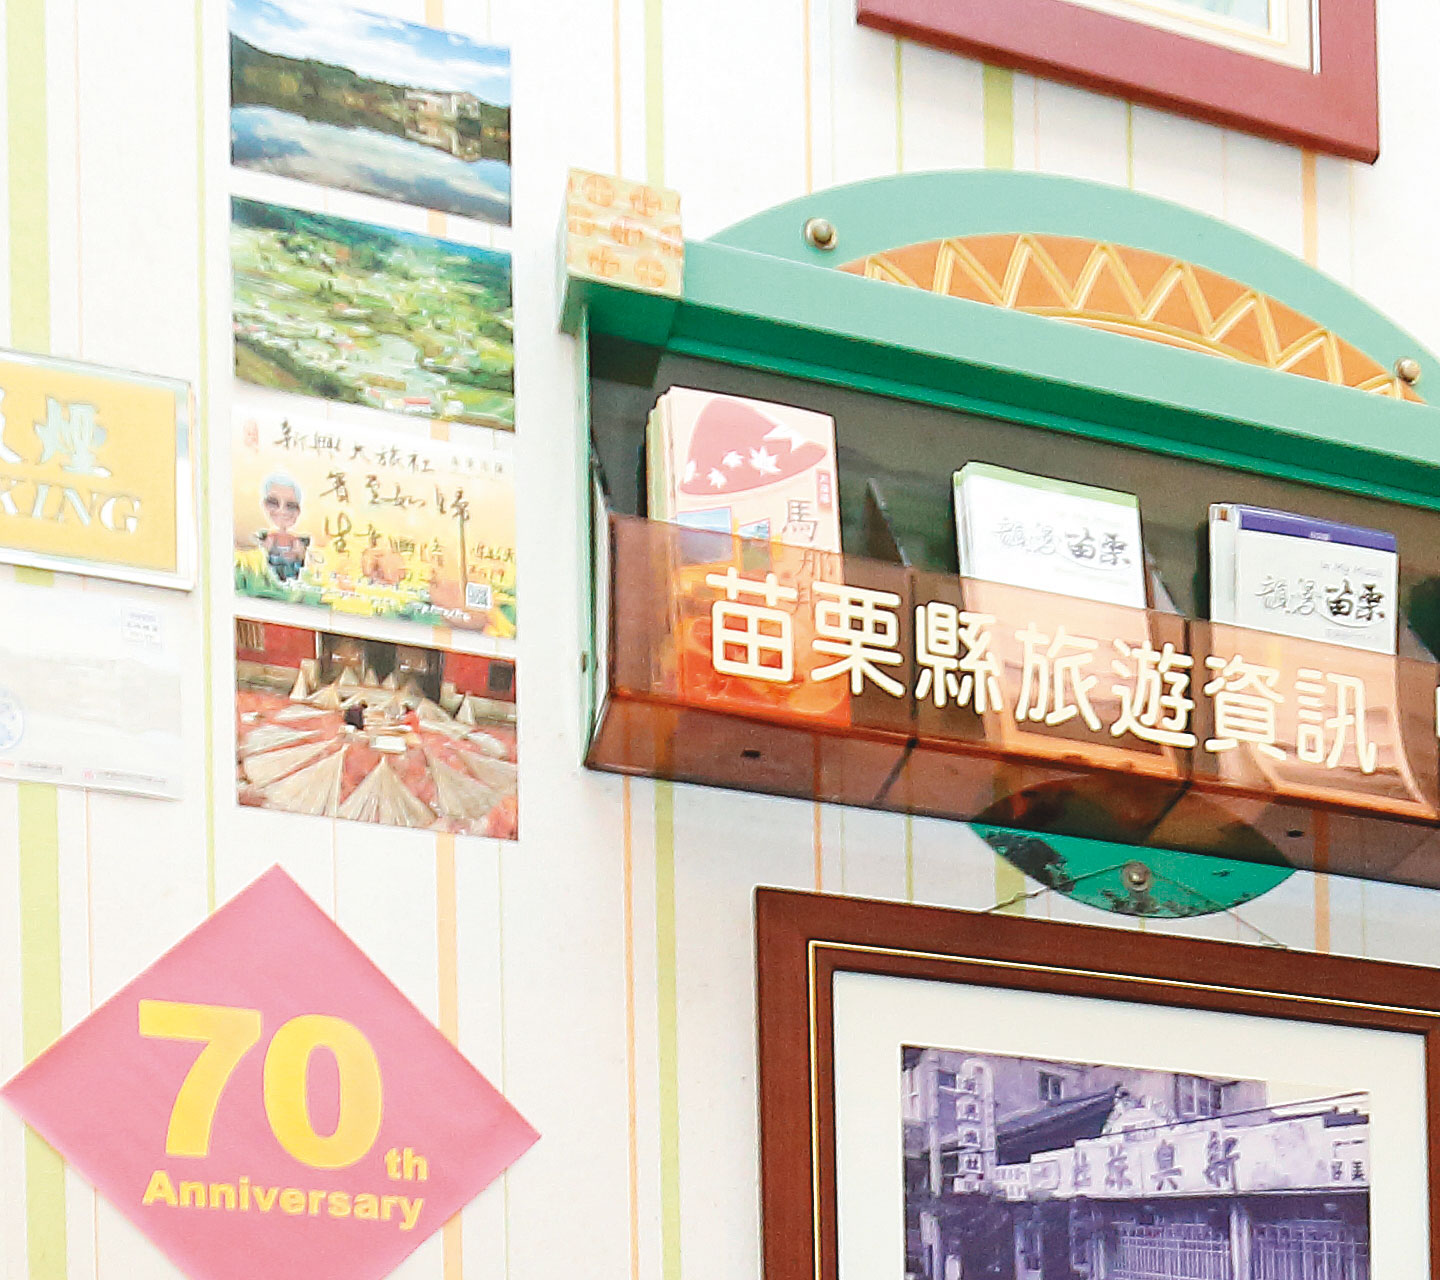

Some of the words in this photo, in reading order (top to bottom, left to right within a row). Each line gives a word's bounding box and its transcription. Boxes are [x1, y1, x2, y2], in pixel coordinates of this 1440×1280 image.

[707, 567, 1377, 774] 苗栗縣旅遊資訊
[143, 1171, 425, 1231] Anniversary
